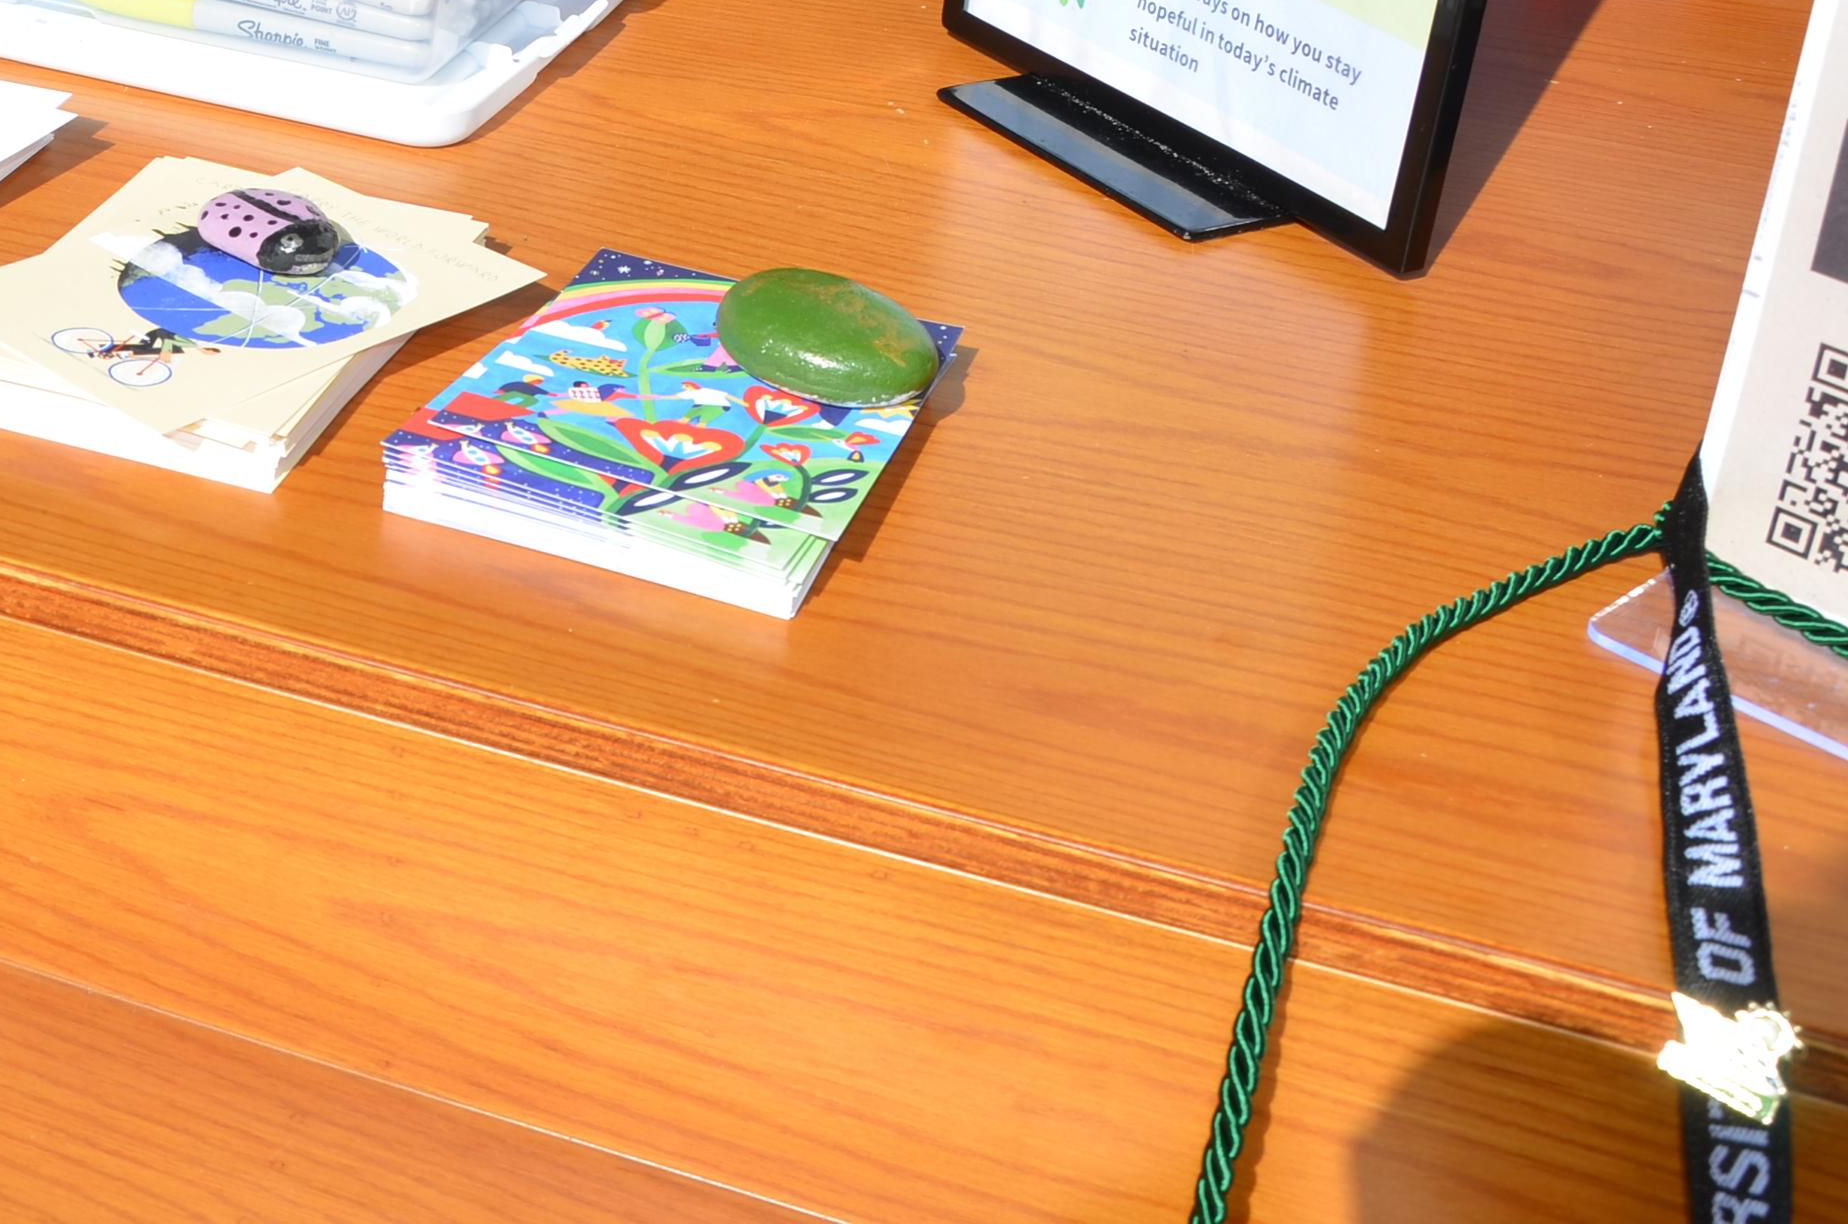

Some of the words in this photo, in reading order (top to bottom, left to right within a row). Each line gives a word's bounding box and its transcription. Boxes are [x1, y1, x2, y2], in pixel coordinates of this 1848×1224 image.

[311, 4, 333, 15] POINT
[1231, 7, 1251, 27] on
[1254, 13, 1290, 47] how
[1291, 36, 1322, 63] you
[1325, 53, 1363, 86] stay
[1129, 26, 1200, 73] situation
[1200, 22, 1216, 45] in
[1217, 33, 1277, 77] today’s
[1278, 67, 1340, 111] climate
[1667, 626, 1744, 889] MARYLAND
[1690, 907, 1756, 987] OF
